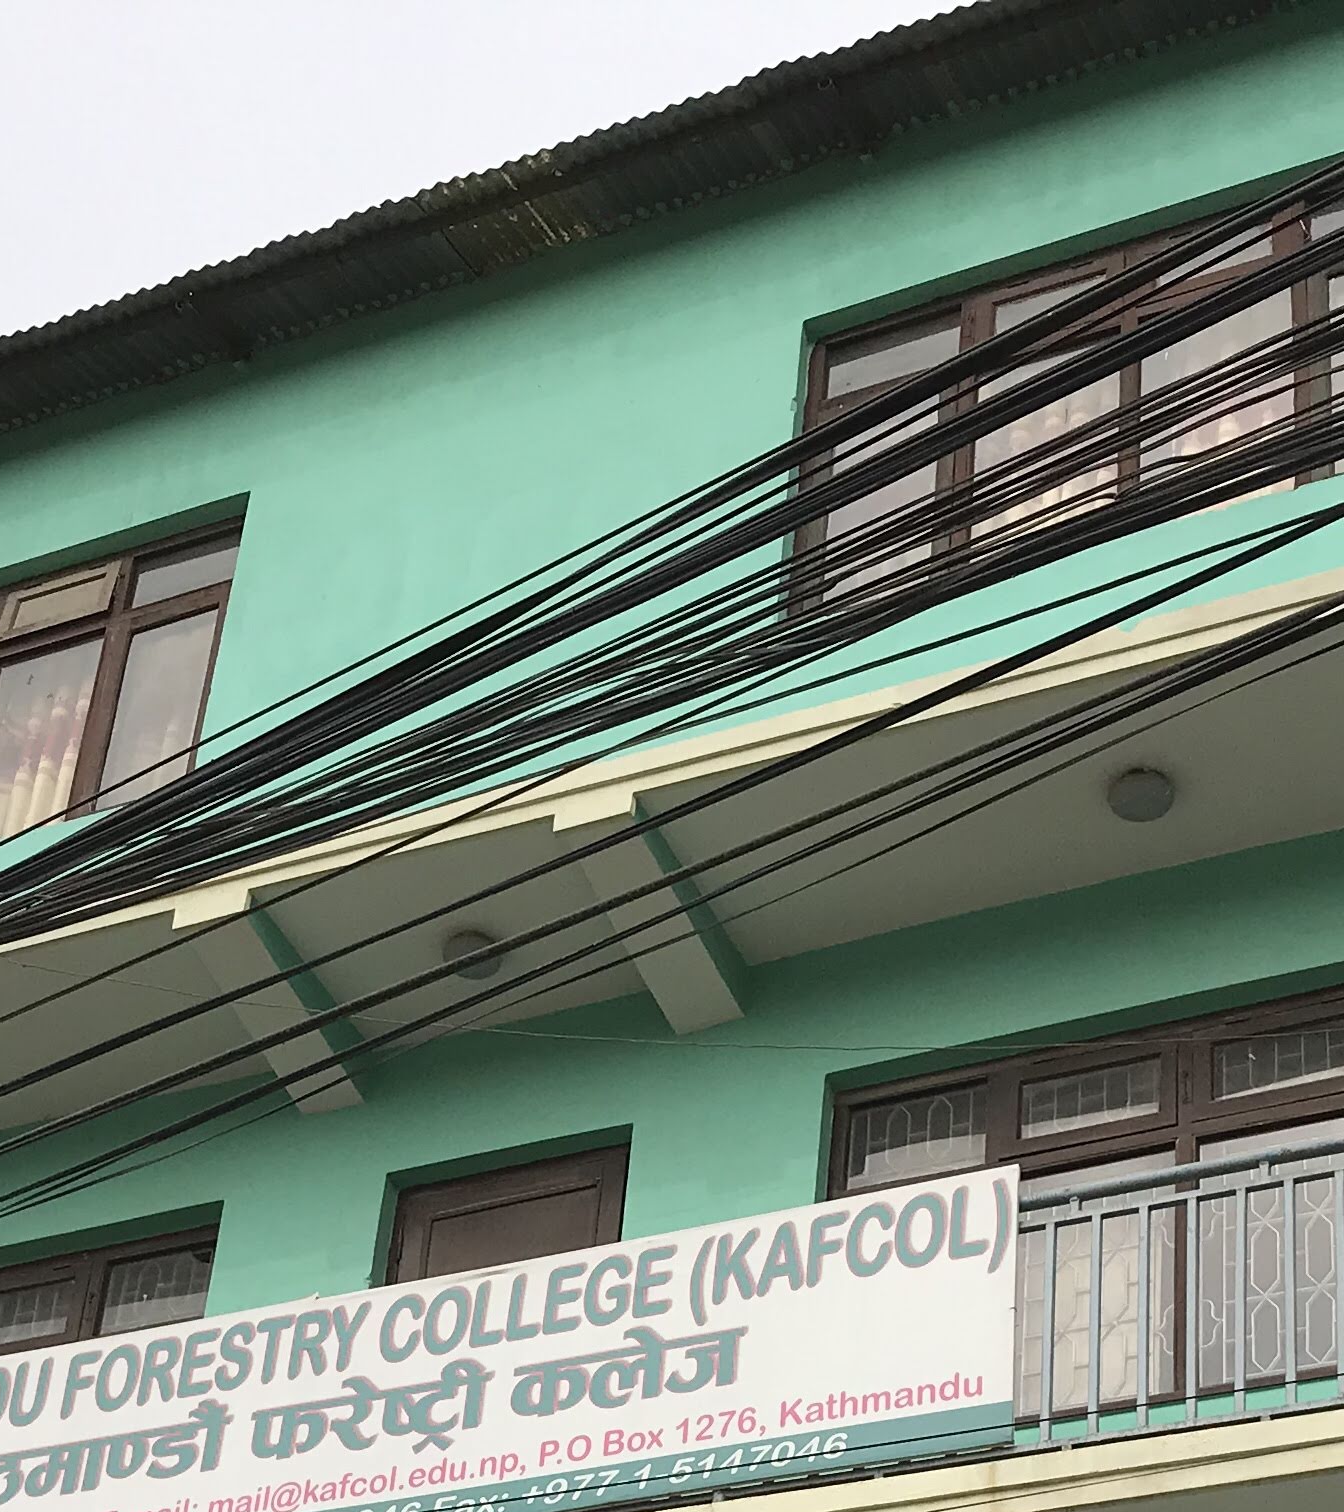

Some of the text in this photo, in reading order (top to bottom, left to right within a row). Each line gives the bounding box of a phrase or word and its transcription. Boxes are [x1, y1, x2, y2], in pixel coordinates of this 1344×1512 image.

[59, 1298, 370, 1421] FORESTRY
[378, 1244, 676, 1364] COLLEGE
[688, 1178, 1012, 1326] (KAFCOL)
[251, 1358, 495, 1461] फरेष्ट्री
[511, 1325, 748, 1417] कलेज
[538, 1434, 592, 1467] P.O
[602, 1426, 665, 1457] Box
[675, 1406, 767, 1445] 1276,
[779, 1373, 985, 1428] Kathmandu
